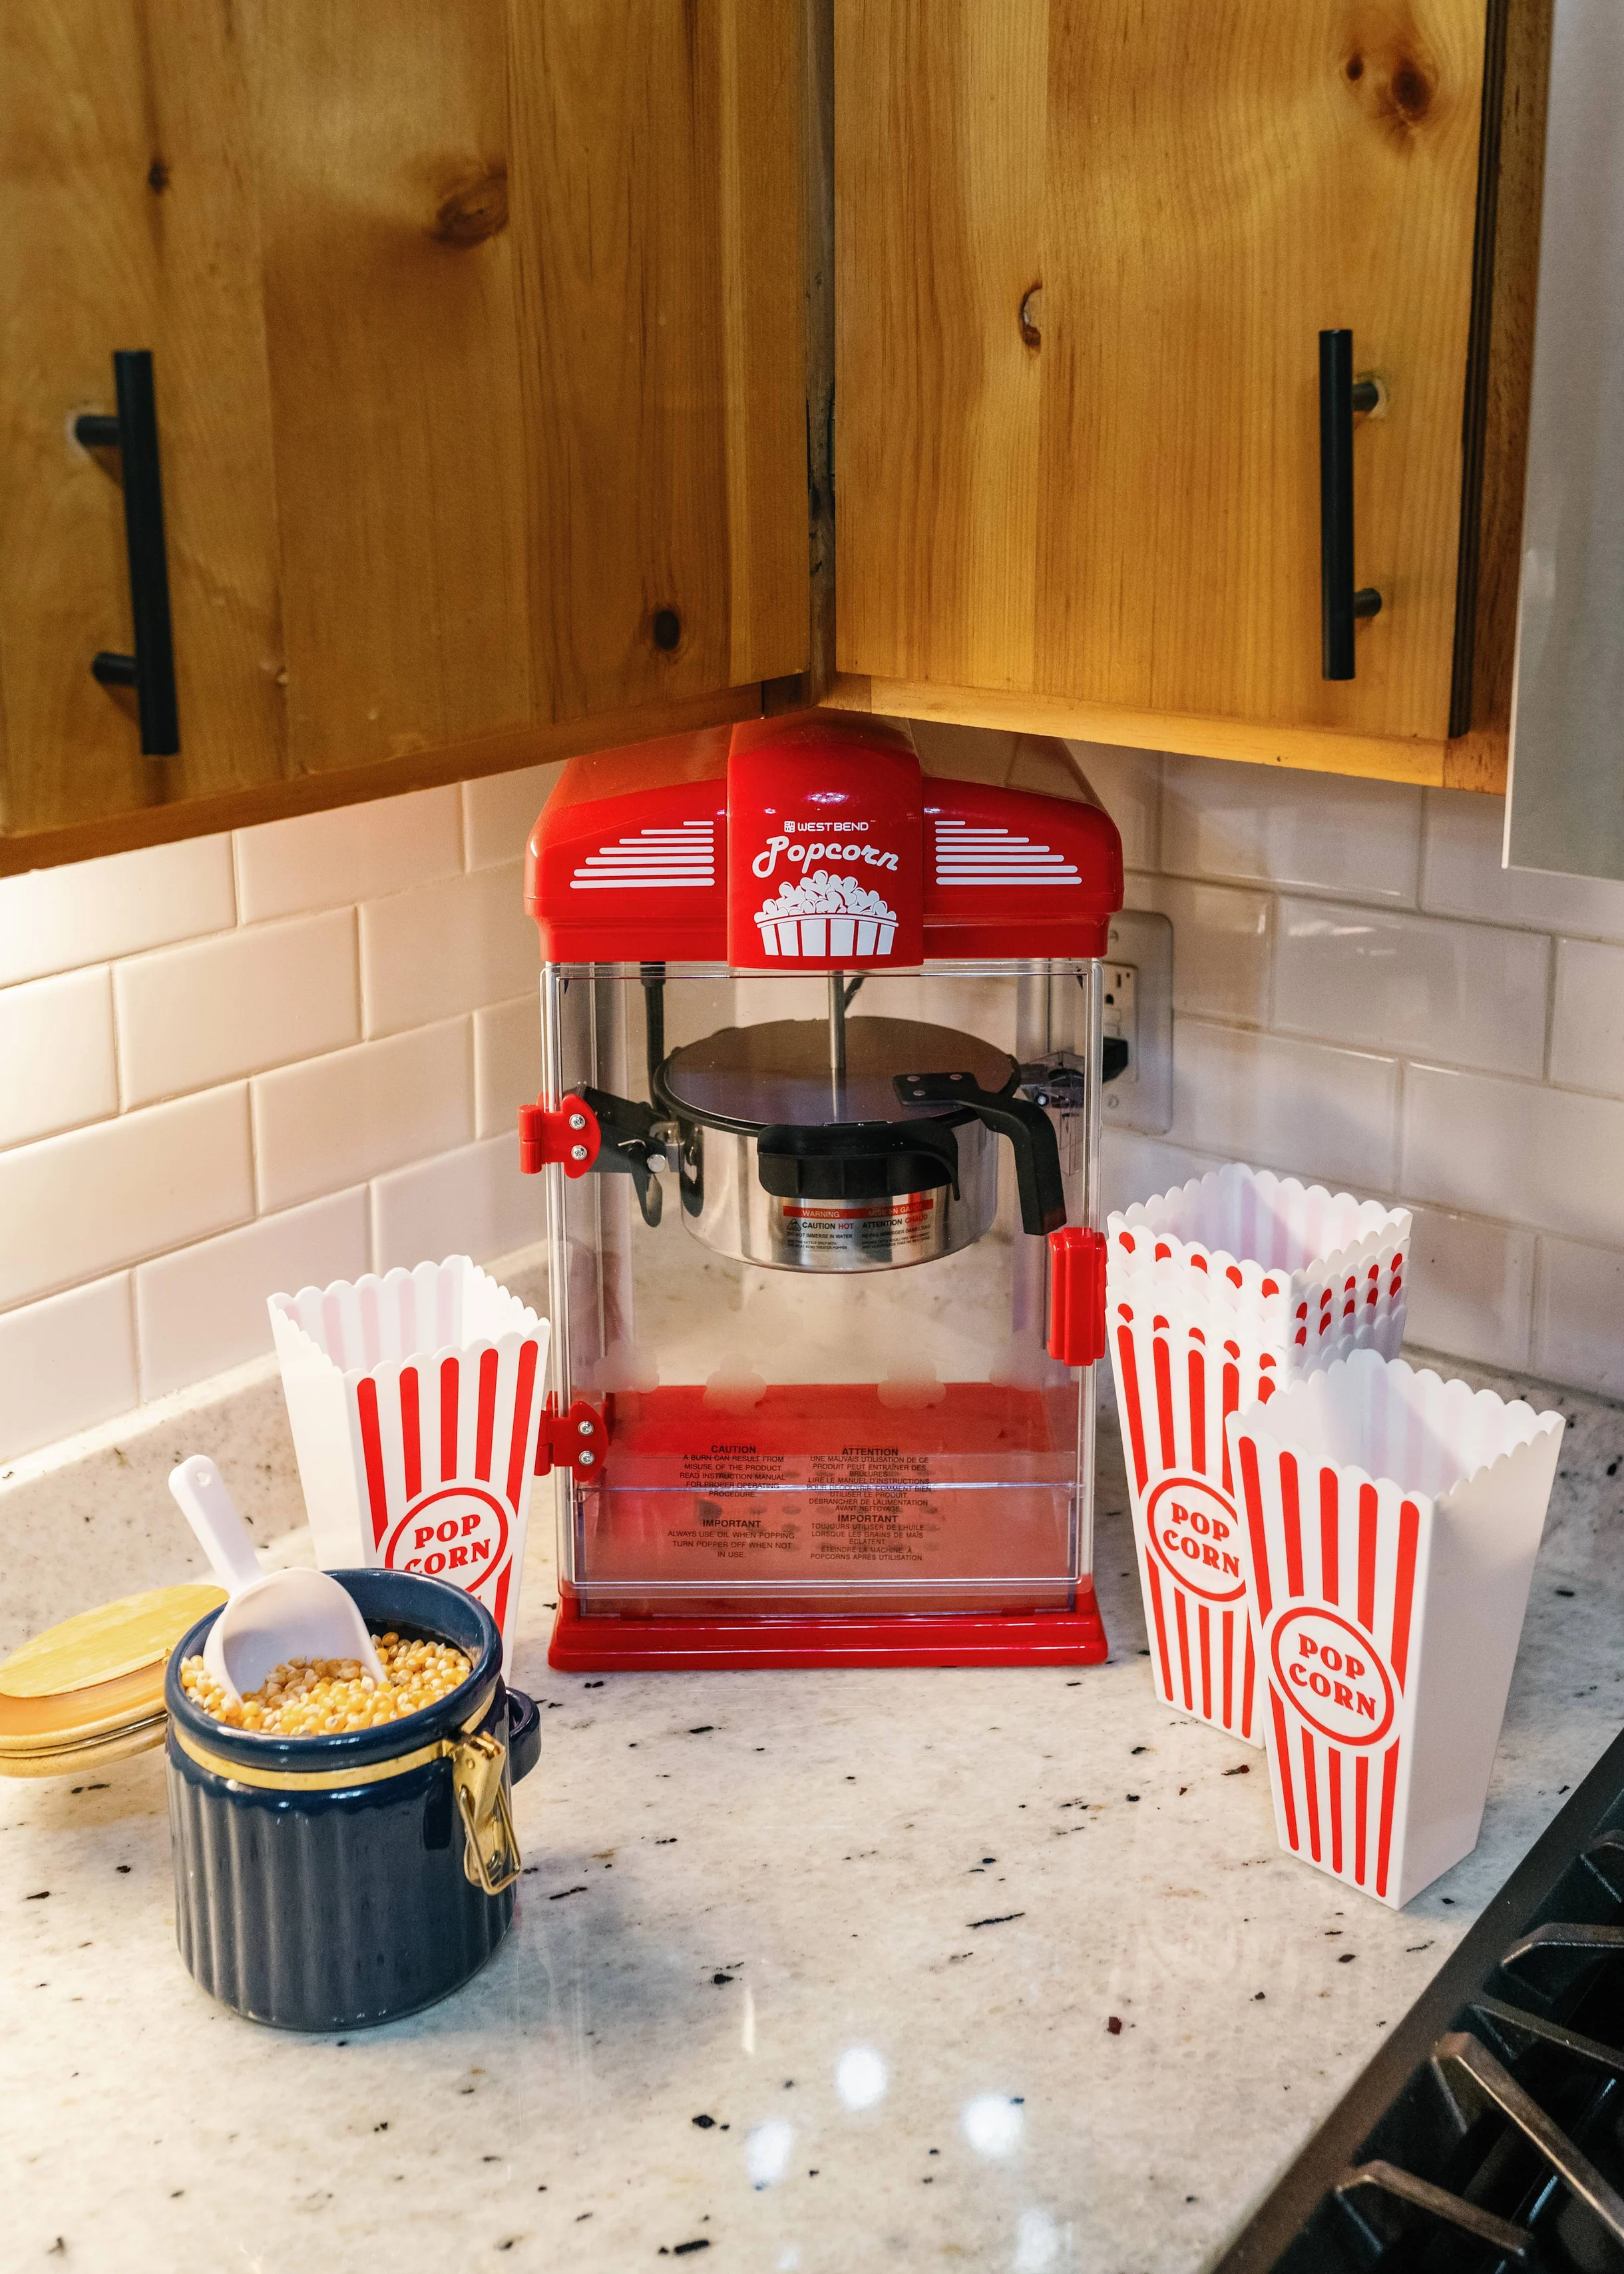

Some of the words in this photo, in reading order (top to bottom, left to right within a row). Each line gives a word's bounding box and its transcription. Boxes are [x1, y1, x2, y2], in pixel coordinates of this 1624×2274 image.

[752, 835, 899, 878] Popcorn
[862, 1218, 903, 1228] ATTENTION
[905, 1214, 928, 1224] CHAUD
[711, 1445, 756, 1454] CAUTION
[842, 1447, 899, 1456] ATTENTION
[415, 1514, 481, 1550] POP
[702, 1519, 761, 1528] IMPORTANT
[1171, 1502, 1230, 1542] POP
[404, 1538, 491, 1574] CORN
[1163, 1529, 1239, 1578] CORN
[1299, 1632, 1365, 1680] POP
[1289, 1663, 1376, 1721] CORN
